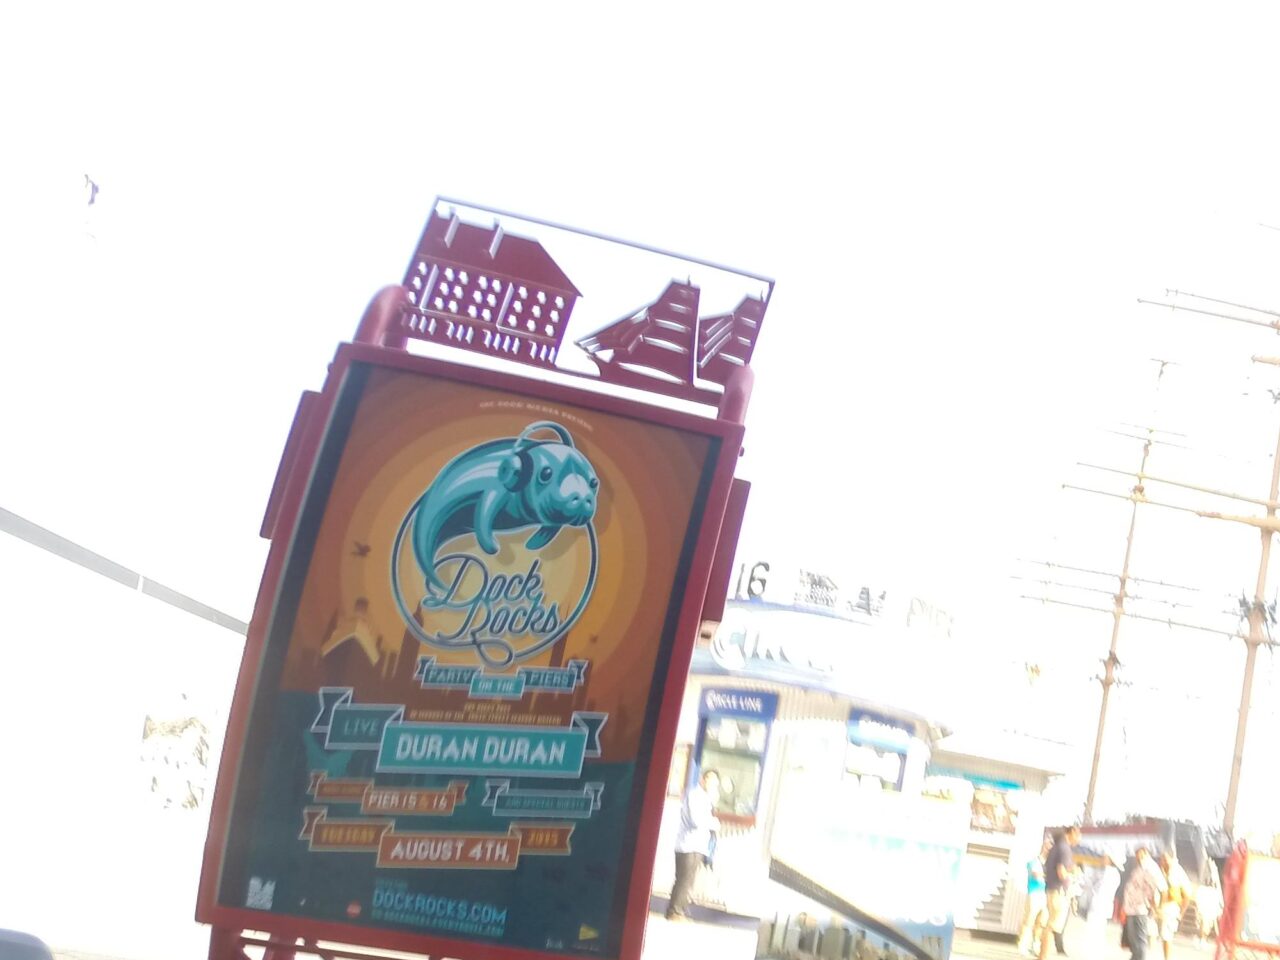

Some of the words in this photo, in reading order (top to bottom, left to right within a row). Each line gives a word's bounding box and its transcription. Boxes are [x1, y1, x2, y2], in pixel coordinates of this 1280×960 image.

[422, 553, 541, 608] Dock
[437, 592, 559, 640] Rocks
[428, 667, 471, 682] PARTY
[530, 671, 569, 686] PIERS
[478, 680, 492, 690] ON
[497, 681, 514, 691] THE
[344, 718, 379, 736] LIVE
[395, 732, 478, 762] DURAN
[482, 735, 566, 765] DURAN
[368, 791, 400, 809] PIER
[402, 792, 417, 809] 15
[432, 794, 448, 809] 16
[390, 839, 464, 861] AUGUST
[372, 886, 508, 925] DOCKROCKS.COM
